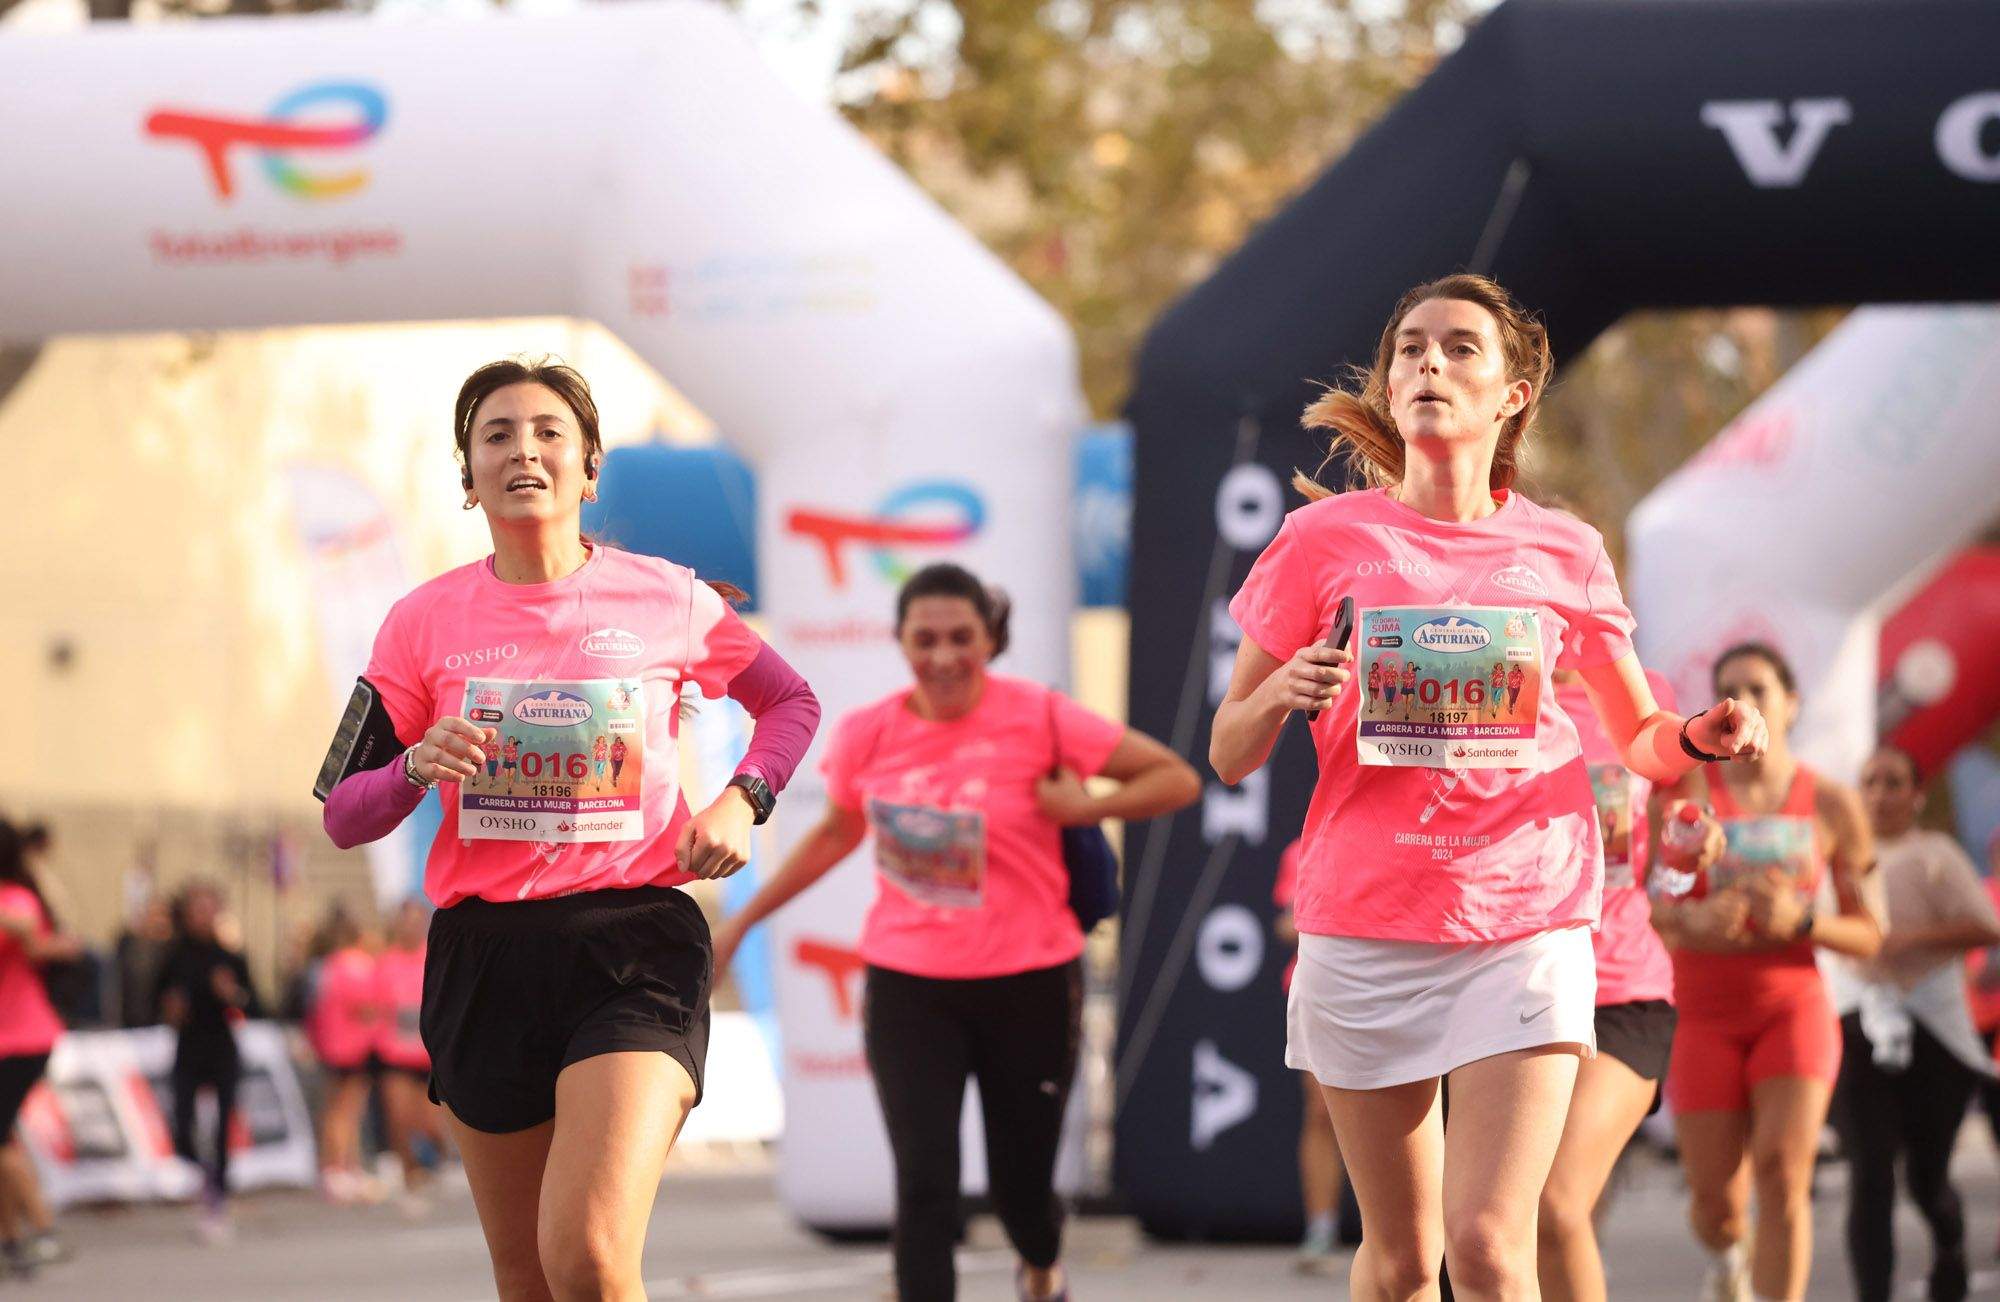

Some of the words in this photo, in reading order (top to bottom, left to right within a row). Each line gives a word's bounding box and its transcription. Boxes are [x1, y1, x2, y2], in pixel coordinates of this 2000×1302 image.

[1356, 559, 1431, 577] OYSHO
[1371, 624, 1401, 633] SUMA
[1418, 629, 1486, 645] ASTURIANA
[445, 643, 519, 670] OYSHO
[1418, 678, 1485, 705] 016
[475, 695, 503, 706] SUMA
[519, 703, 588, 719] ASTURIANA
[1429, 711, 1469, 724] 18197
[1375, 723, 1413, 734] CARRERA
[1414, 725, 1426, 735] DE
[1427, 726, 1439, 736] LA
[1440, 726, 1468, 737] MUJER
[1474, 725, 1521, 736] BARCELONA
[1377, 742, 1433, 757] OYSHO
[1467, 746, 1520, 758] Santander
[520, 751, 589, 779] 016
[532, 784, 572, 798] 18196
[478, 797, 516, 809] CARRERA
[517, 799, 529, 809] DE
[531, 799, 542, 809] LA
[544, 800, 572, 811] MUJER
[578, 798, 625, 810] BARCELONA
[480, 815, 537, 831] OYSHO
[571, 820, 624, 833] Santander
[1394, 832, 1433, 847] CARRERA
[1435, 834, 1447, 847] DE
[1449, 835, 1460, 848] LA
[1462, 834, 1491, 847] MUJER
[1431, 847, 1454, 861] 2024
